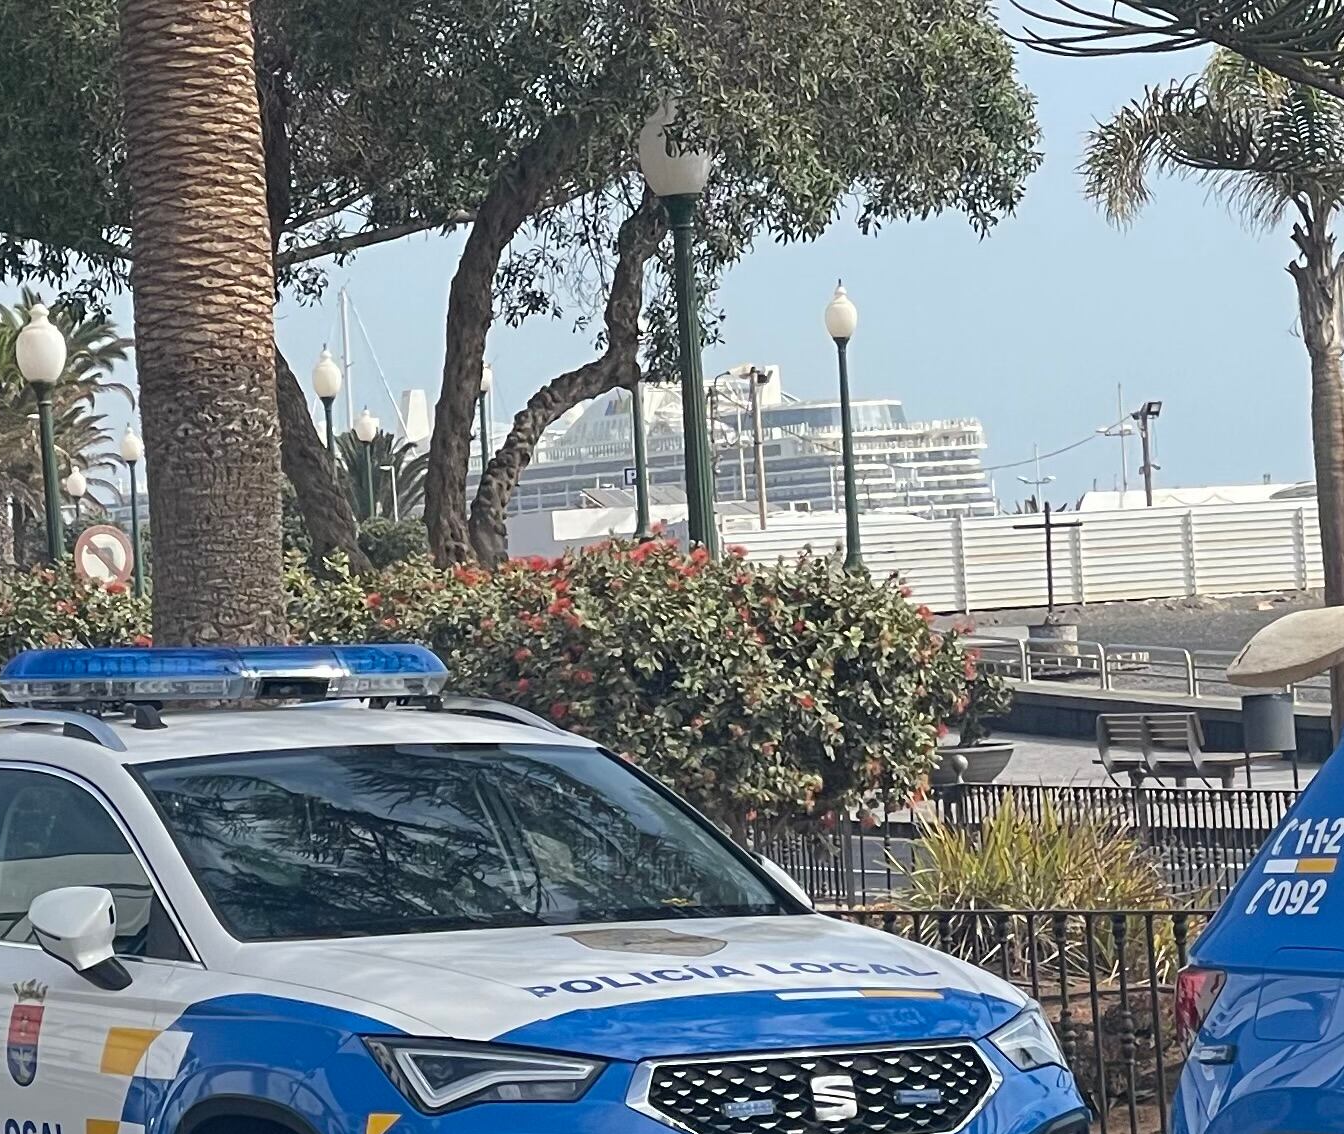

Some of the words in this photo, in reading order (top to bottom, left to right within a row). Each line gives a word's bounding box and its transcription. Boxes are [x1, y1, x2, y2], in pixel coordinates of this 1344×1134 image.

[1267, 879, 1327, 915] 092
[523, 963, 754, 999] POLICÍA
[756, 961, 939, 977] LOCAL
